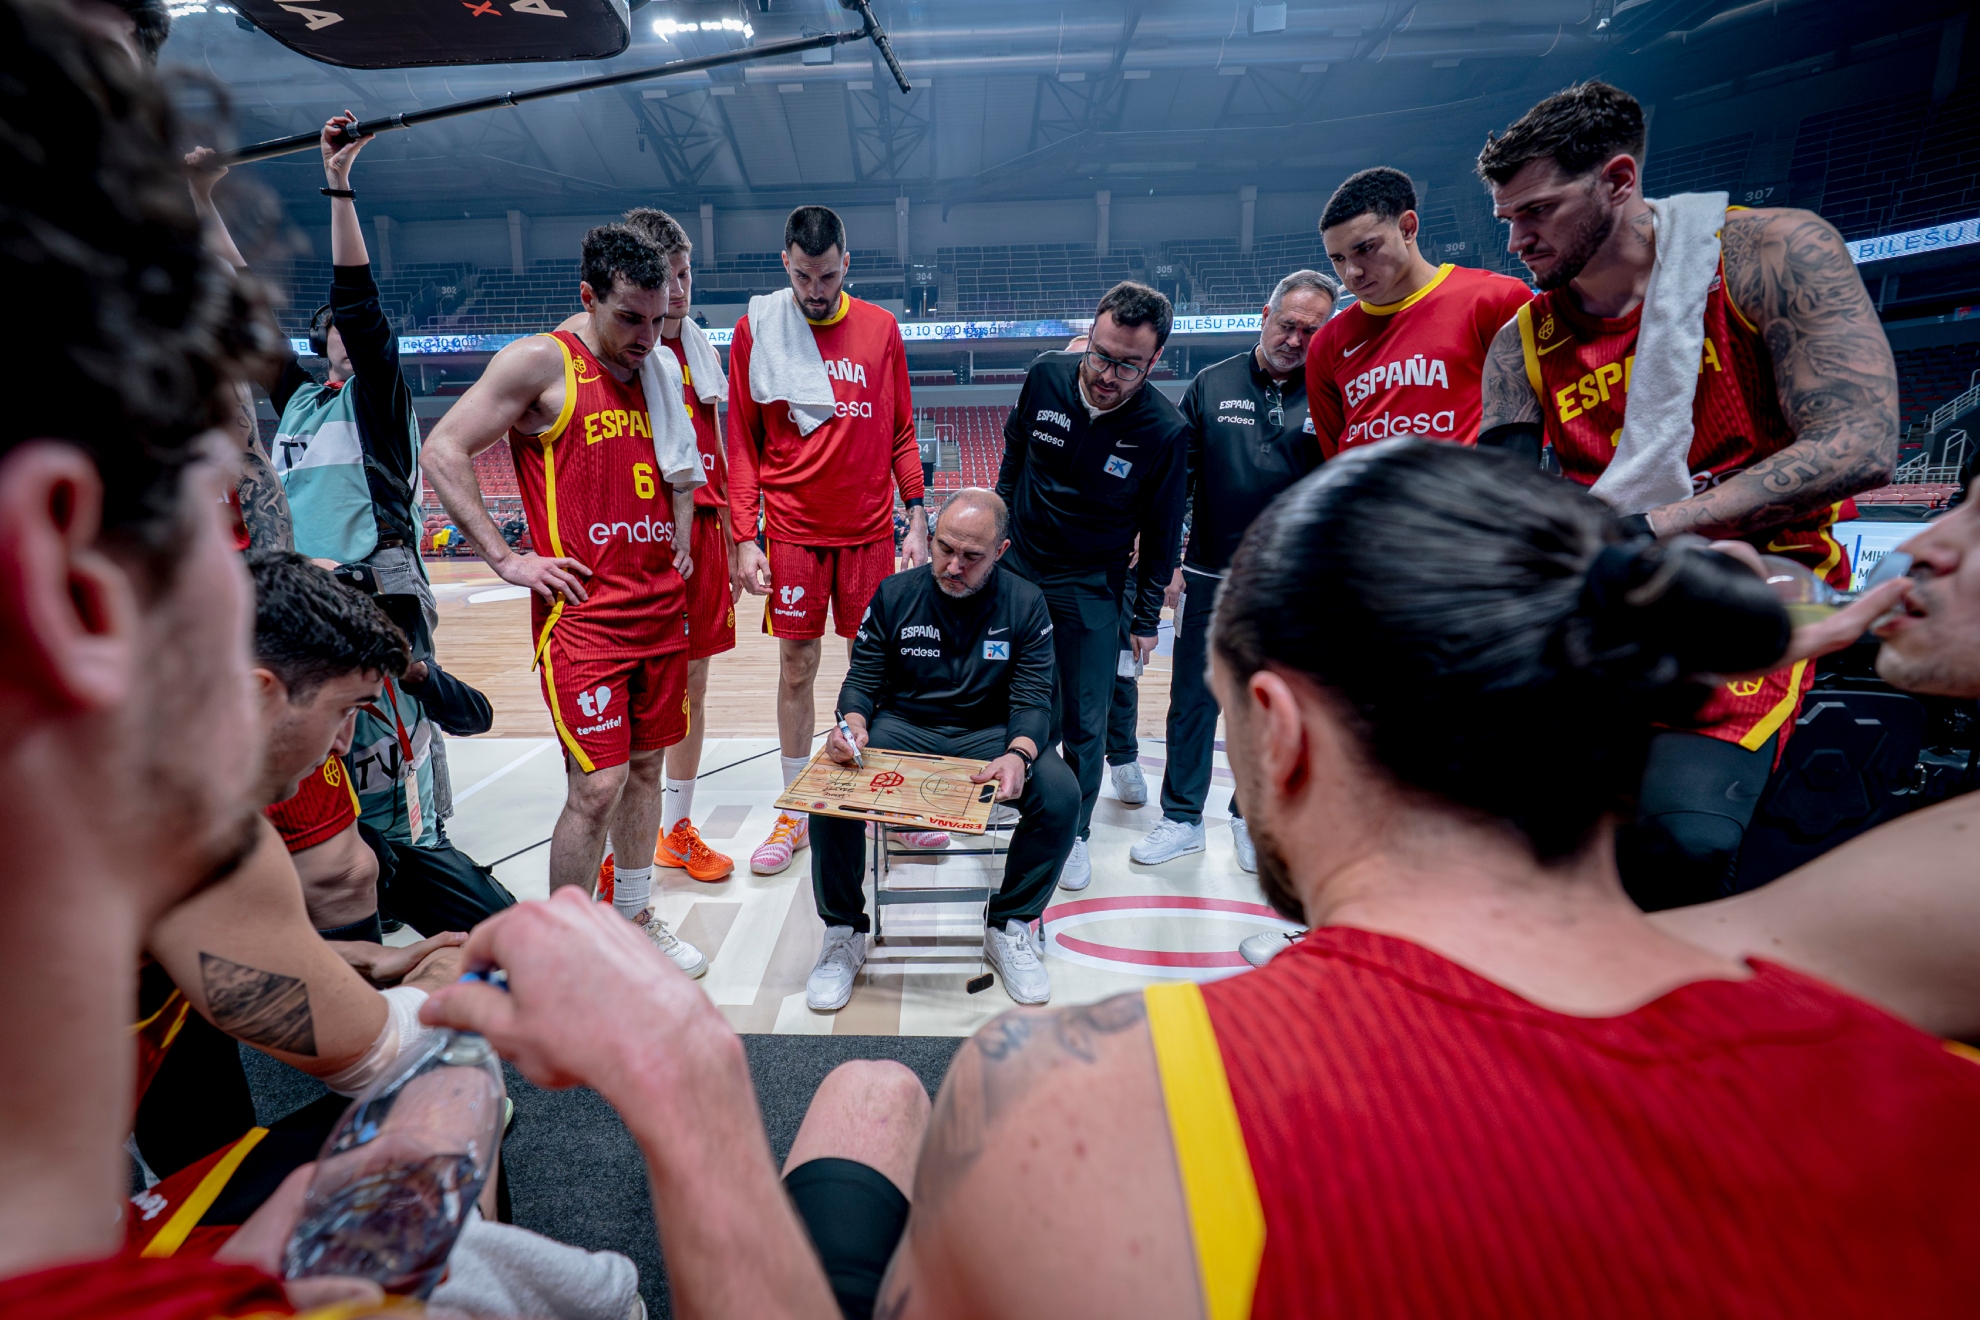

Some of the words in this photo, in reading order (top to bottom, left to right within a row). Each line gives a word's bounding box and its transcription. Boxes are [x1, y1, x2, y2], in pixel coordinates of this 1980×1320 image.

[1744, 187, 1774, 202] 307
[1444, 241, 1466, 253] 306
[916, 272, 932, 281] 304
[1156, 265, 1172, 274] 305
[441, 286, 457, 294] 302
[917, 325, 930, 336] 10
[935, 324, 961, 336] 000
[1173, 316, 1222, 333] BIĻEŠU
[825, 357, 867, 388] AÑA
[1344, 354, 1449, 408] ESPAÑA
[1556, 337, 1722, 424] ESPA
[1219, 399, 1255, 412] ESPAÑA
[584, 409, 653, 446] ESPA
[1036, 410, 1071, 432] ESPAÑA
[1217, 415, 1255, 426] endesa
[1346, 410, 1455, 442] endesa
[1032, 429, 1065, 447] endesa
[633, 462, 655, 499] 6
[588, 515, 675, 545] endes
[901, 624, 941, 642] ESPAÑA
[900, 646, 941, 658] endesa
[355, 742, 399, 791] TV
[929, 817, 982, 830] ESPAÑA
